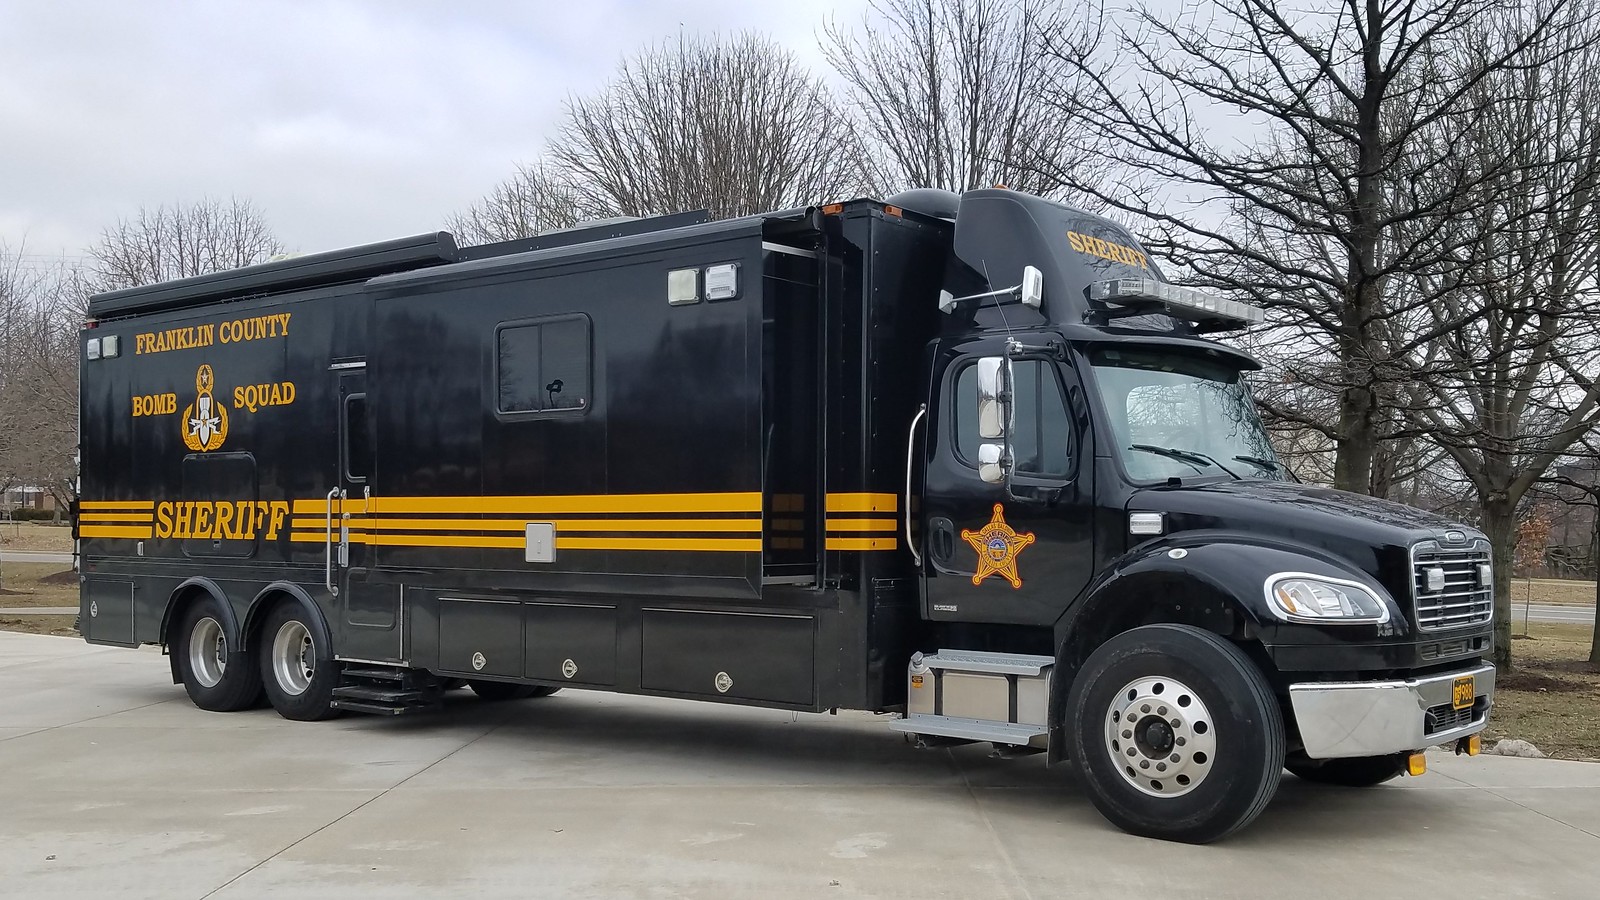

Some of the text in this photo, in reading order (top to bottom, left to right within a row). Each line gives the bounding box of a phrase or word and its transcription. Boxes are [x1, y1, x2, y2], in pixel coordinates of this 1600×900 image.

[1067, 231, 1147, 270] SHERIFF
[135, 312, 291, 355] FRANKLIN COUNTY
[132, 381, 296, 417] BOMB SQUAD
[155, 500, 290, 540] SHERIFF
